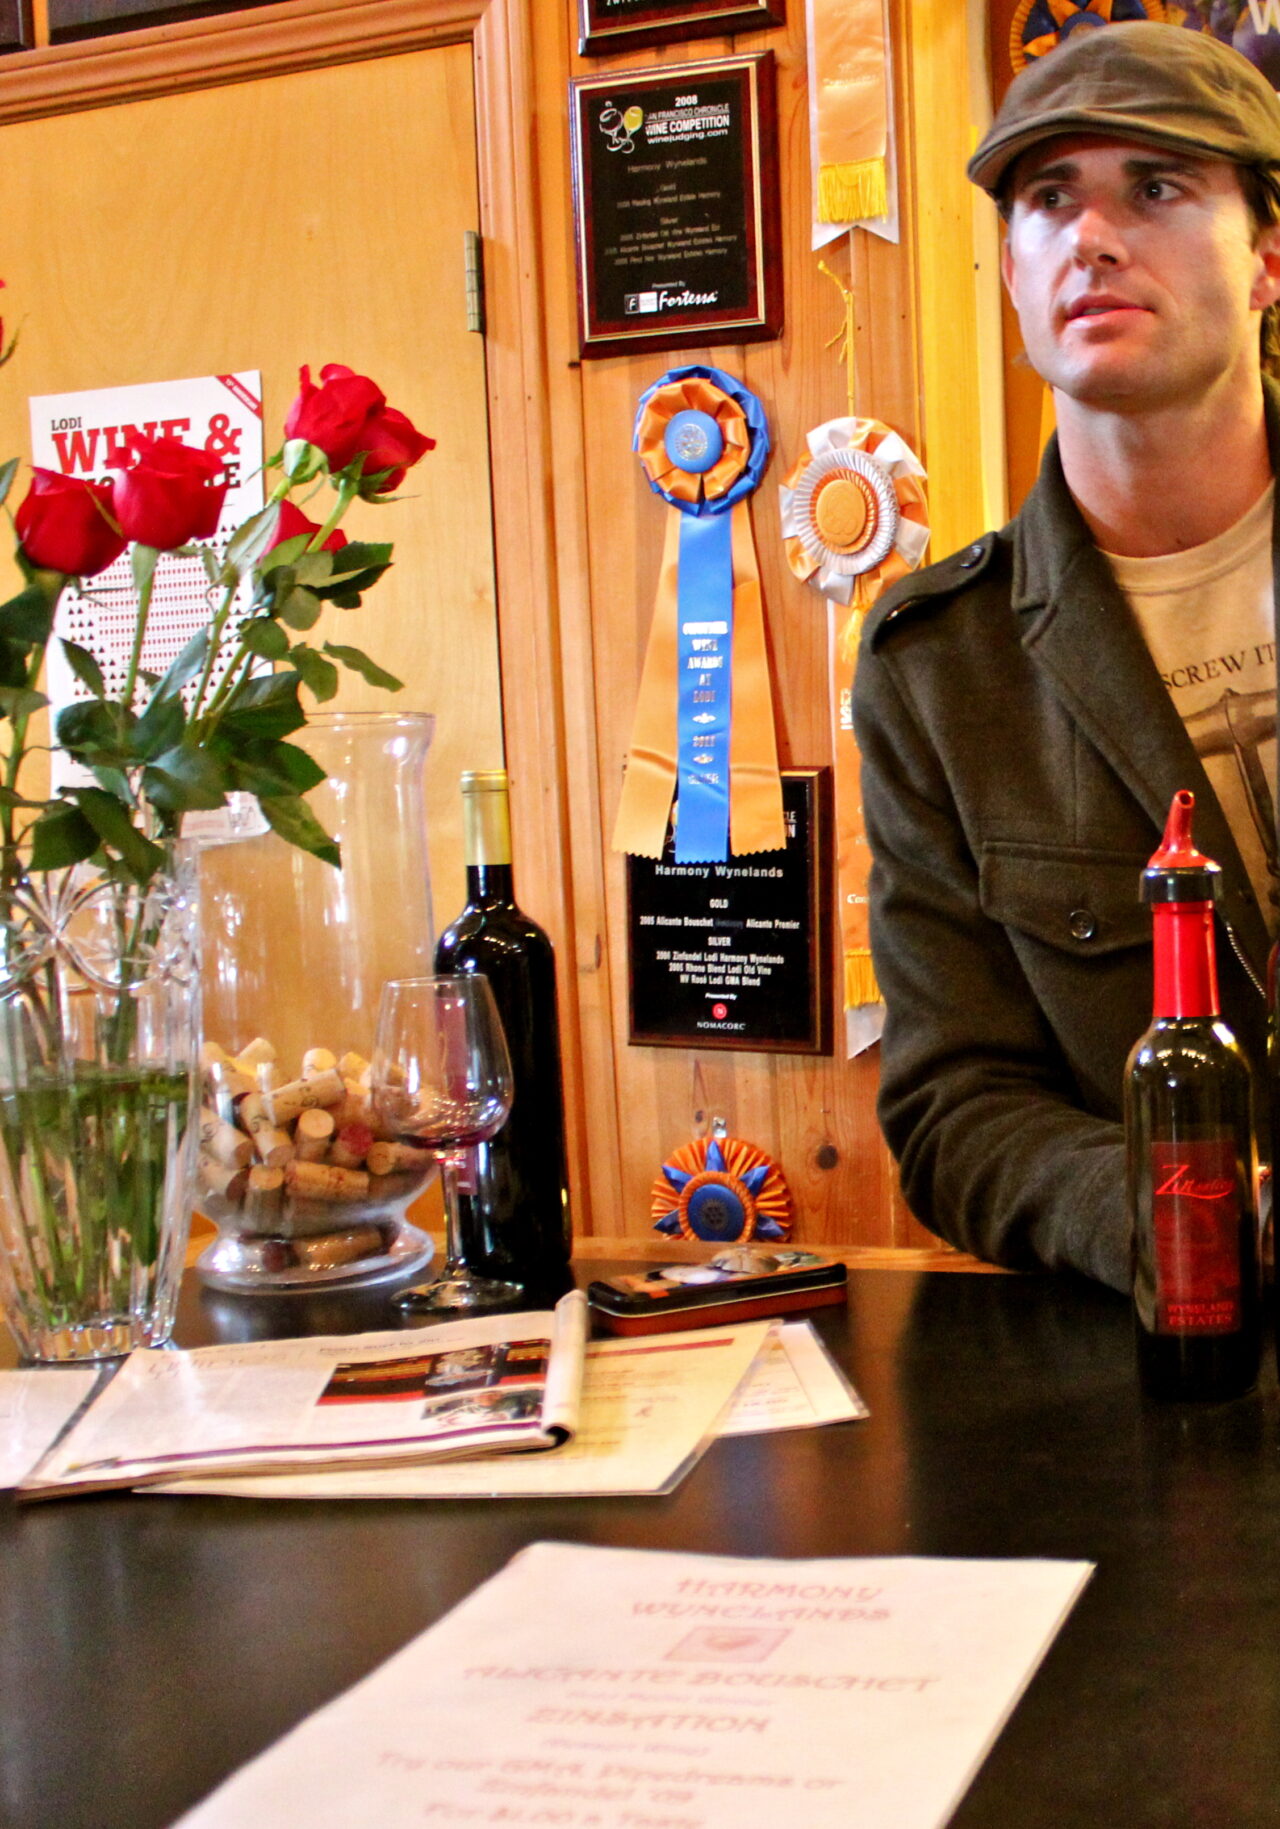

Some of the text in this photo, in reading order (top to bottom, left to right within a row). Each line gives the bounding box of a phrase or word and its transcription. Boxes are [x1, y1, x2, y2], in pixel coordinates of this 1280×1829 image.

[675, 95, 698, 107] 2008
[658, 107, 693, 119] FRANCISCO
[694, 103, 729, 117] CHRONICLE
[645, 115, 730, 136] WINE COMPETITION
[647, 129, 728, 144] winejudging.com
[659, 290, 718, 311] Fortessa
[51, 417, 82, 431] LODI
[204, 413, 242, 458] &
[1160, 651, 1245, 690] SCREW
[655, 865, 784, 879] Harmony Wynelands
[709, 899, 729, 909] GOLD
[656, 916, 682, 926] Alicante
[684, 917, 714, 927] Bouschet
[746, 919, 773, 929] Alicante
[774, 919, 800, 929] Premier
[708, 936, 731, 947] SILVER
[672, 951, 702, 961] Zinfandel
[704, 952, 718, 962] Lodi
[720, 953, 748, 965] Harmony
[749, 954, 784, 965] Wynelands
[707, 964, 725, 974] Blend
[728, 965, 742, 974] Lodi
[744, 965, 755, 975] Old
[757, 965, 772, 975] Vine
[709, 975, 723, 985] Lodi
[742, 976, 761, 986] Blend
[697, 1021, 746, 1031] NOMACORC
[1168, 1315, 1232, 1326] ESTATES
[677, 1577, 884, 1601] HARMONY
[688, 1667, 942, 1694] BOUSCHET
